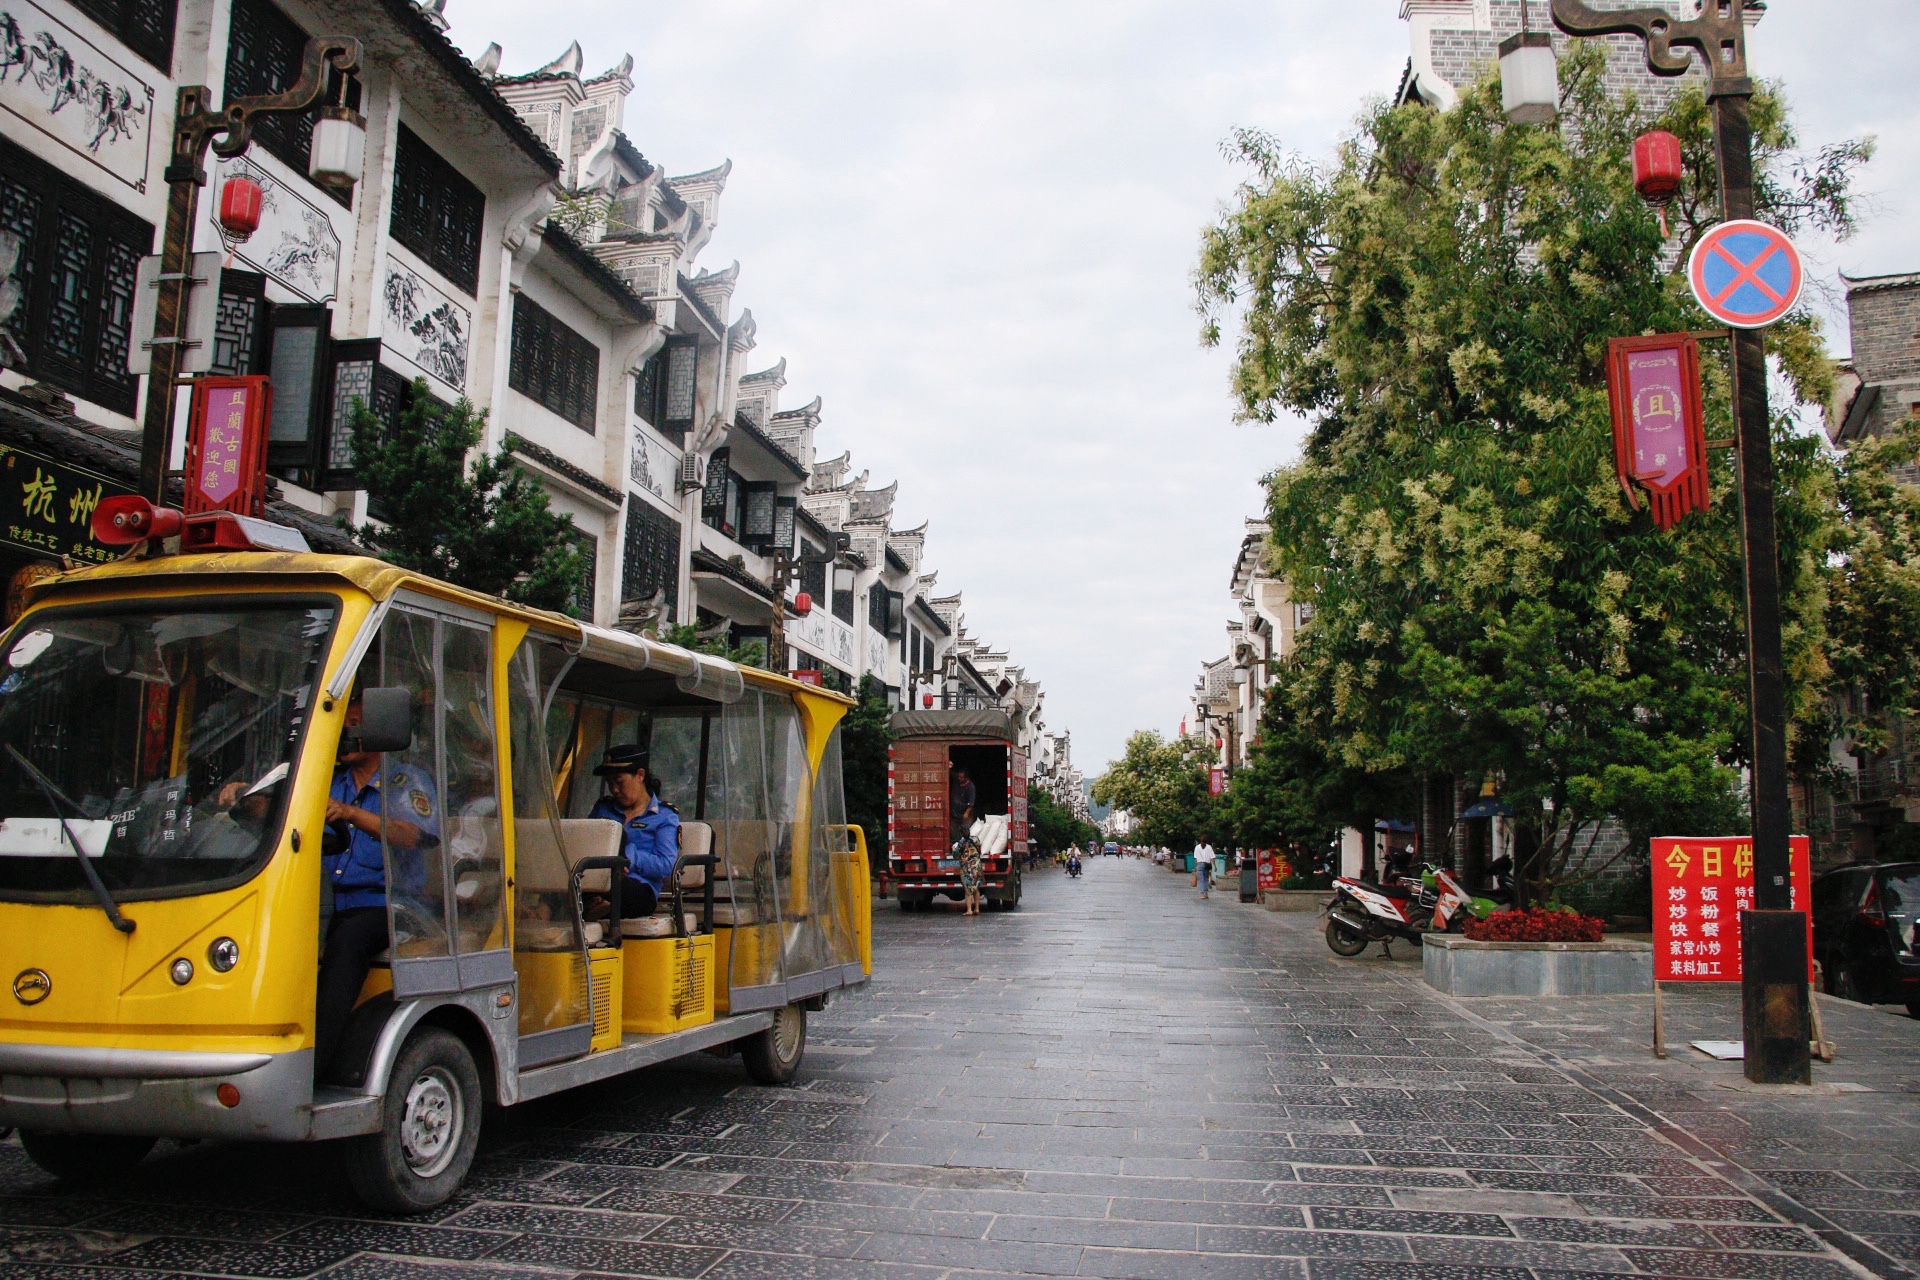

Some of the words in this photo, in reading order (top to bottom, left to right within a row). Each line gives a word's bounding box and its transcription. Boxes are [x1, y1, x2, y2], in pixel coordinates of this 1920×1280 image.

[1642, 394, 1673, 418] 且
[223, 391, 245, 474] 且蘭古國
[204, 426, 224, 489] 歡迎您
[9, 525, 59, 550] 传统工艺
[72, 543, 124, 563] 纯老面发
[1665, 845, 1796, 878] 今日供
[1668, 886, 1718, 901] 炒饭
[1669, 904, 1719, 919] 炒粉
[1669, 922, 1720, 937] 快餐
[1670, 940, 1721, 956] 家常小炒
[1671, 960, 1722, 976] 来料加工
